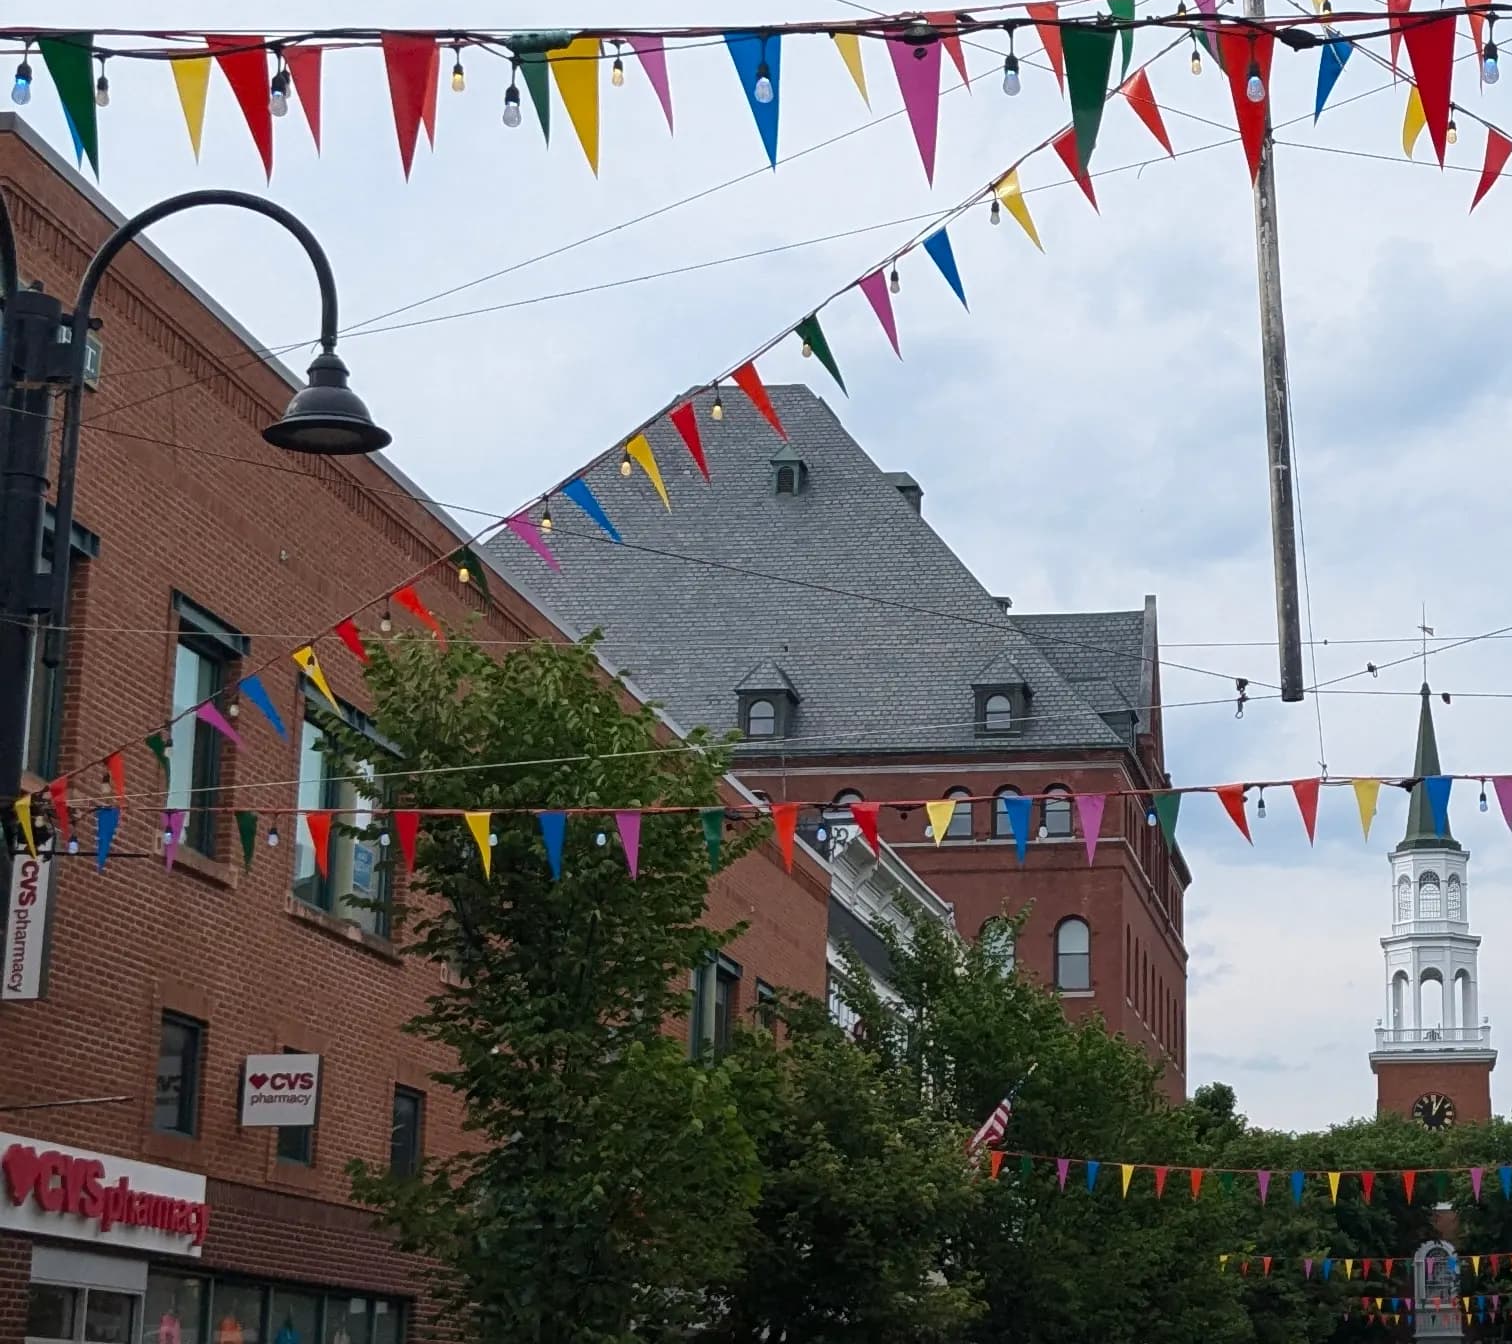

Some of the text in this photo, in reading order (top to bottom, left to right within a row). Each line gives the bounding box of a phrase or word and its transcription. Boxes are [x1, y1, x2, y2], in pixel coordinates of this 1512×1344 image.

[8, 860, 40, 993] CVS pharmacy
[250, 1092, 312, 1106] pharmacy
[270, 1072, 314, 1091] CVS
[34, 1150, 211, 1247] CVS pharmacy
